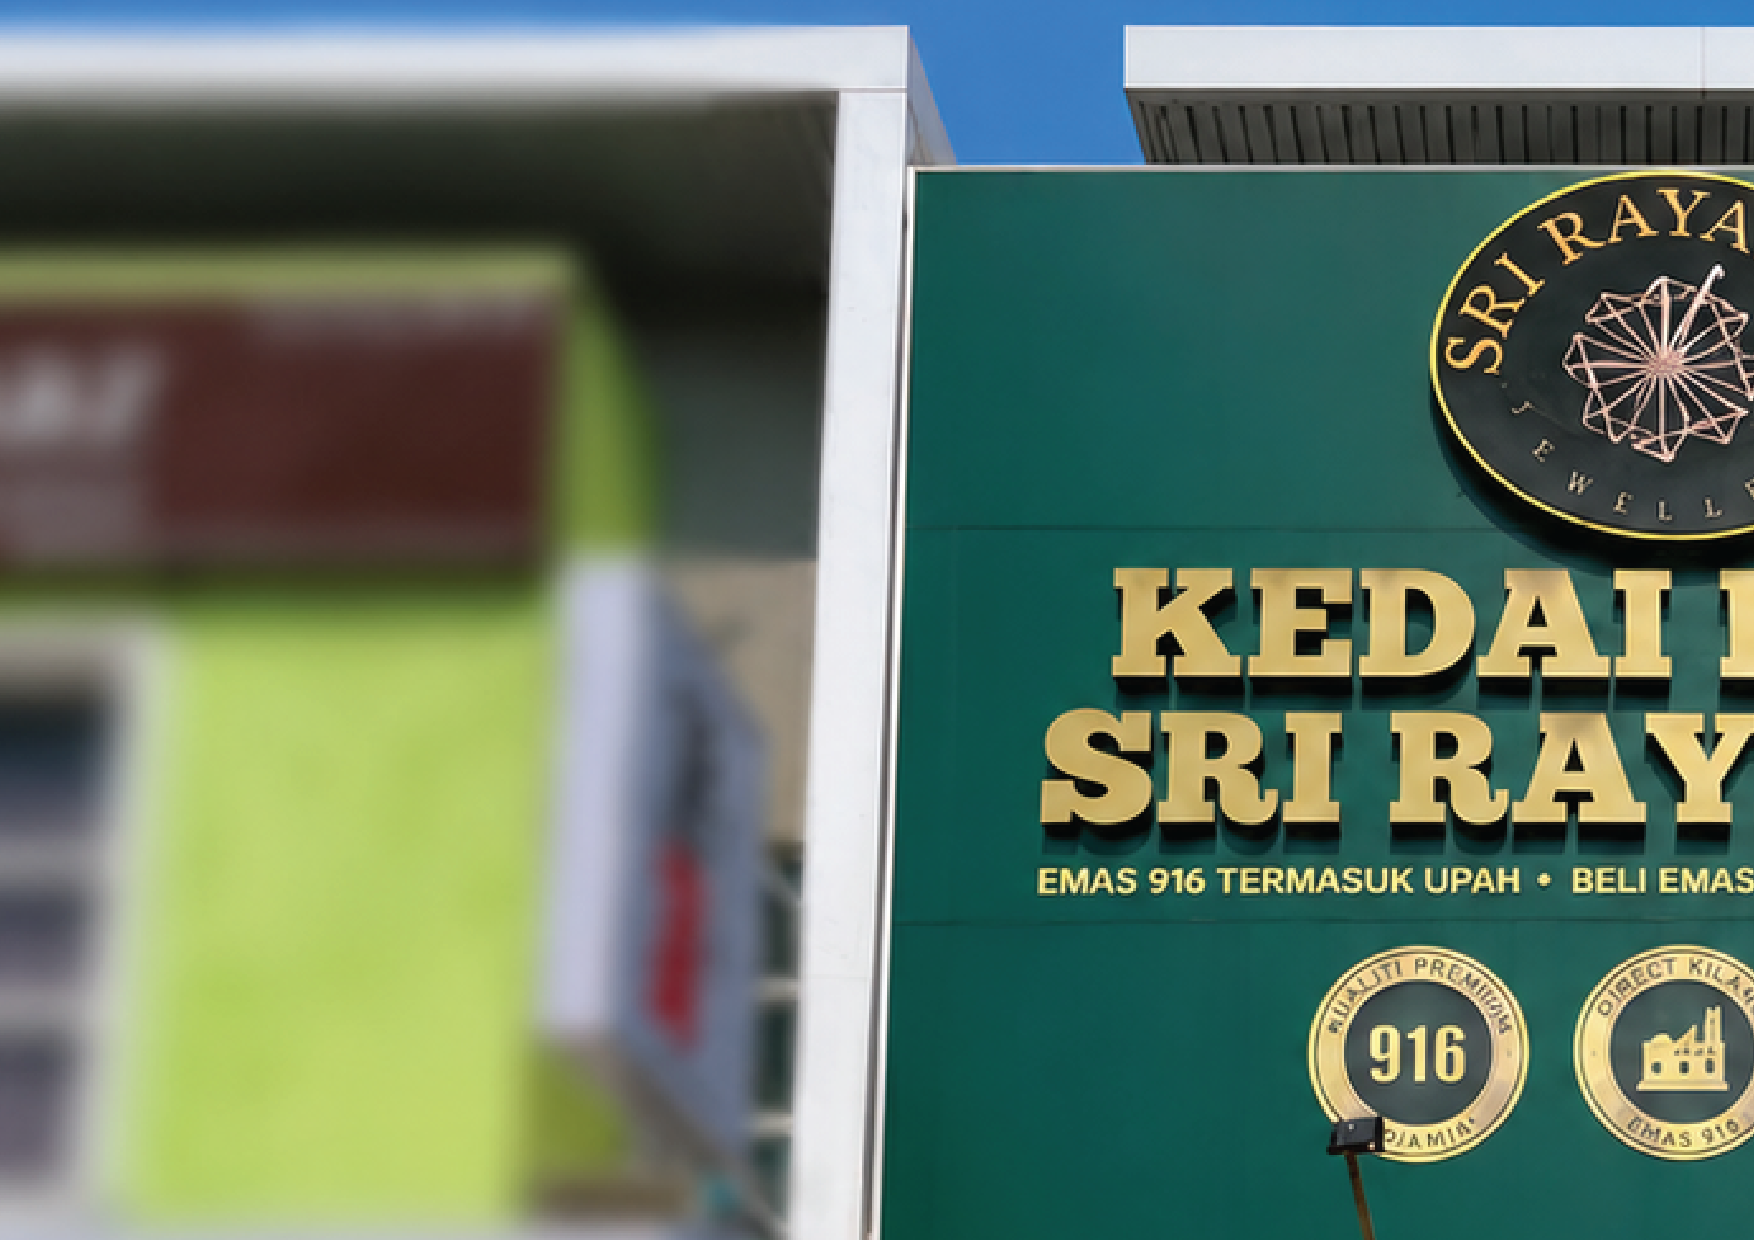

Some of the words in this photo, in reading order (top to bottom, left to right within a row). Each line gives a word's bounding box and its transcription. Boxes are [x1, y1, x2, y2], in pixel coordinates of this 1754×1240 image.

[1445, 252, 1546, 376] SRI
[1112, 567, 1673, 678] KEDAI
[1040, 707, 1343, 825] SRI
[1037, 866, 1138, 895] EMAS
[1147, 866, 1207, 895] 916
[1215, 866, 1415, 895] TERMASUK
[1423, 866, 1521, 895] UPAH
[1571, 866, 1648, 895] BELI
[1368, 1023, 1467, 1084] 916
